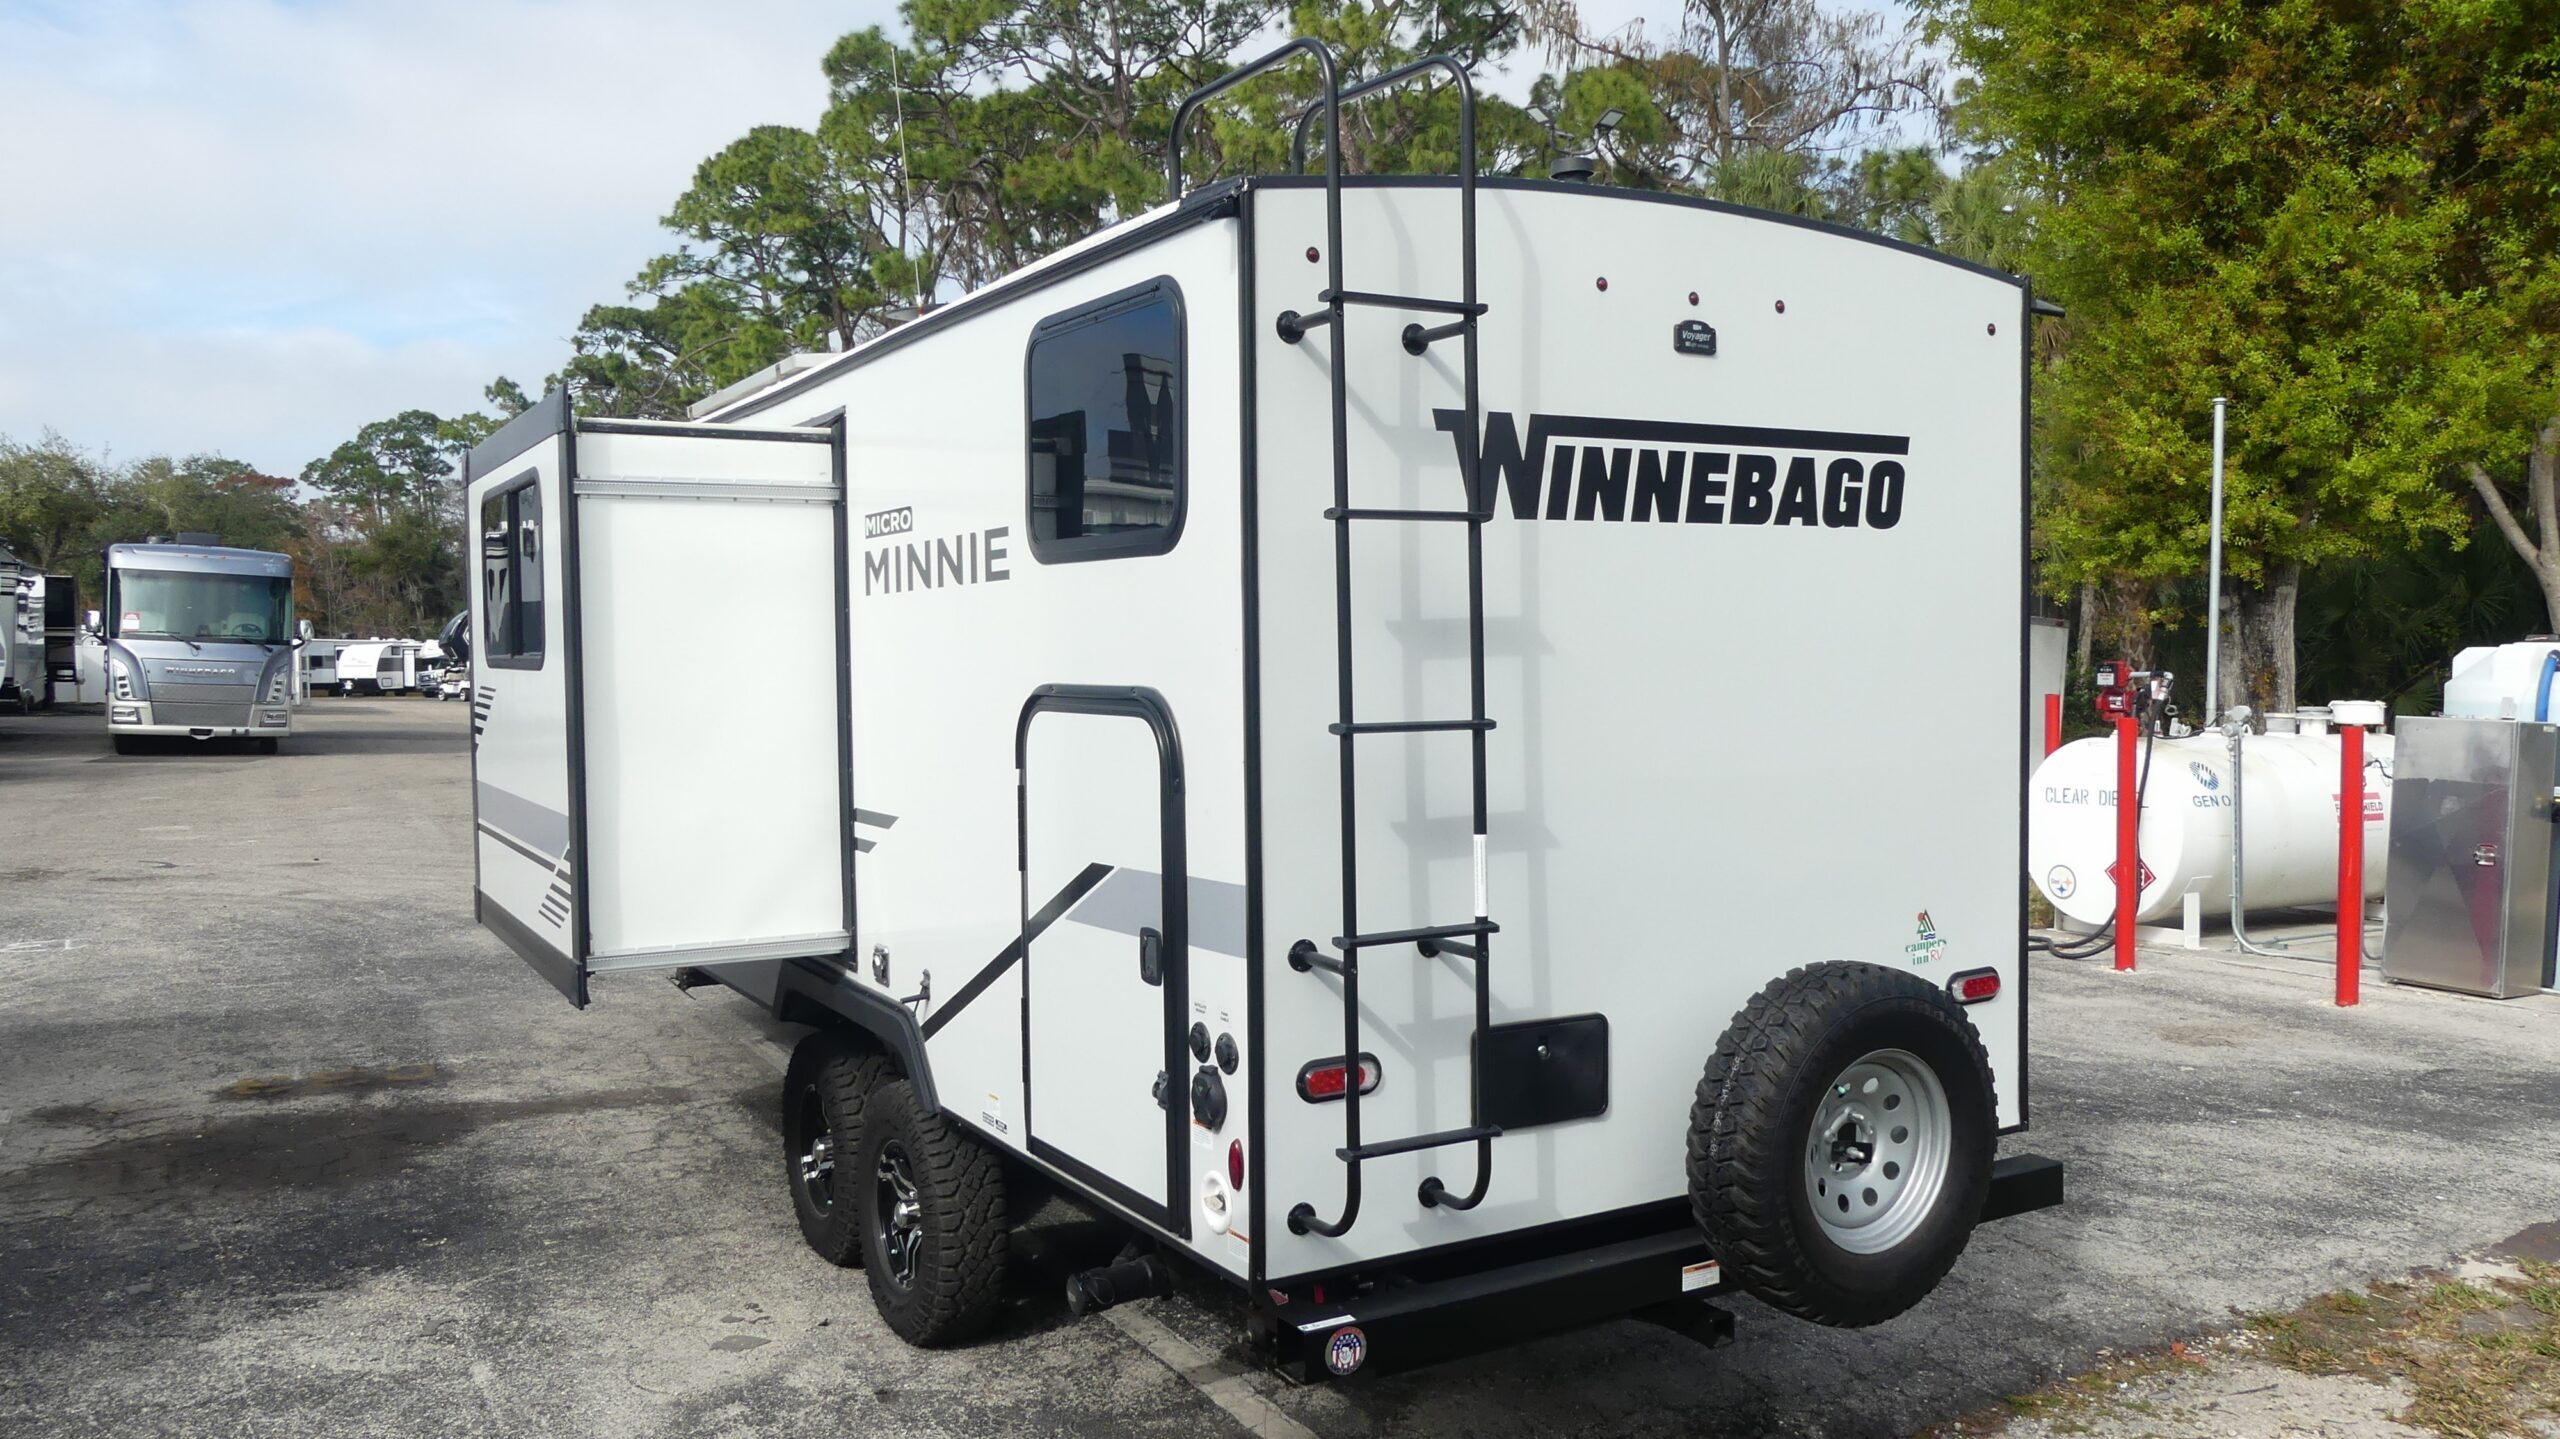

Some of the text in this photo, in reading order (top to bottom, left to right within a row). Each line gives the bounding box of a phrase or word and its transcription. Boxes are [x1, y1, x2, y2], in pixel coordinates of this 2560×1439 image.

[1682, 330, 1711, 342] Voyager
[1432, 408, 1910, 530] WINNEBAGO
[865, 509, 912, 537] MICRO
[865, 526, 1010, 596] MINNIE
[2045, 786, 2089, 805] CLEAR
[2192, 794, 2220, 808] GEN
[1905, 939, 1948, 953] campers
[1912, 947, 1945, 965] inn RV
